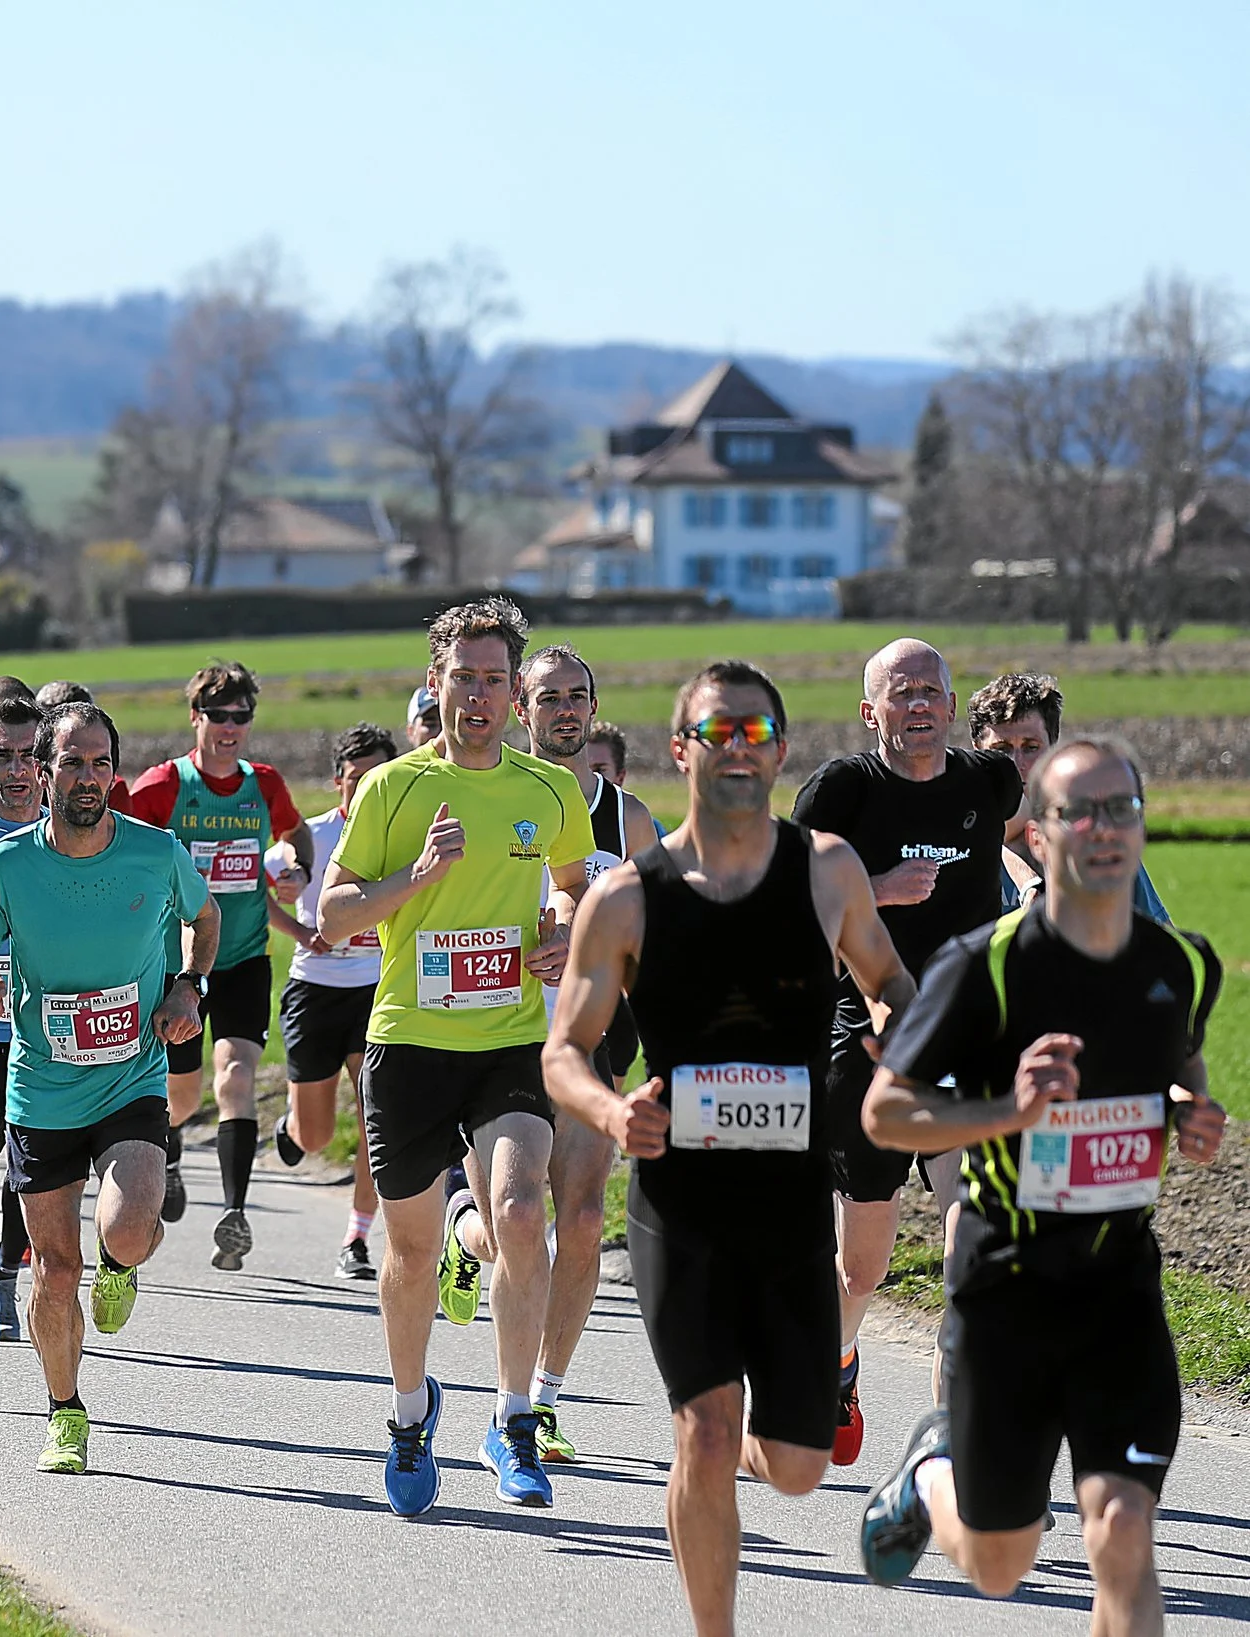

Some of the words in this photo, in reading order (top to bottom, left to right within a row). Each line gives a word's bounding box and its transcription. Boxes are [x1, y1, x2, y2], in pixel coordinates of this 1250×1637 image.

[203, 815, 261, 830] GETTNAU
[218, 857, 253, 871] 1090
[433, 930, 506, 948] MIGROS
[463, 953, 513, 976] 1247
[476, 977, 501, 988] JÜRG
[52, 1001, 90, 1010] Groupe
[92, 992, 129, 1006] Mutuel
[86, 1011, 133, 1035] 1052
[95, 1033, 128, 1045] CLAUDE
[61, 1052, 97, 1062] MIGROS
[695, 1067, 786, 1084] MIGROS
[718, 1103, 806, 1128] 50317
[1050, 1103, 1143, 1125] MIGROS
[1086, 1133, 1151, 1167] 1079
[1093, 1165, 1139, 1183] CARLOS
